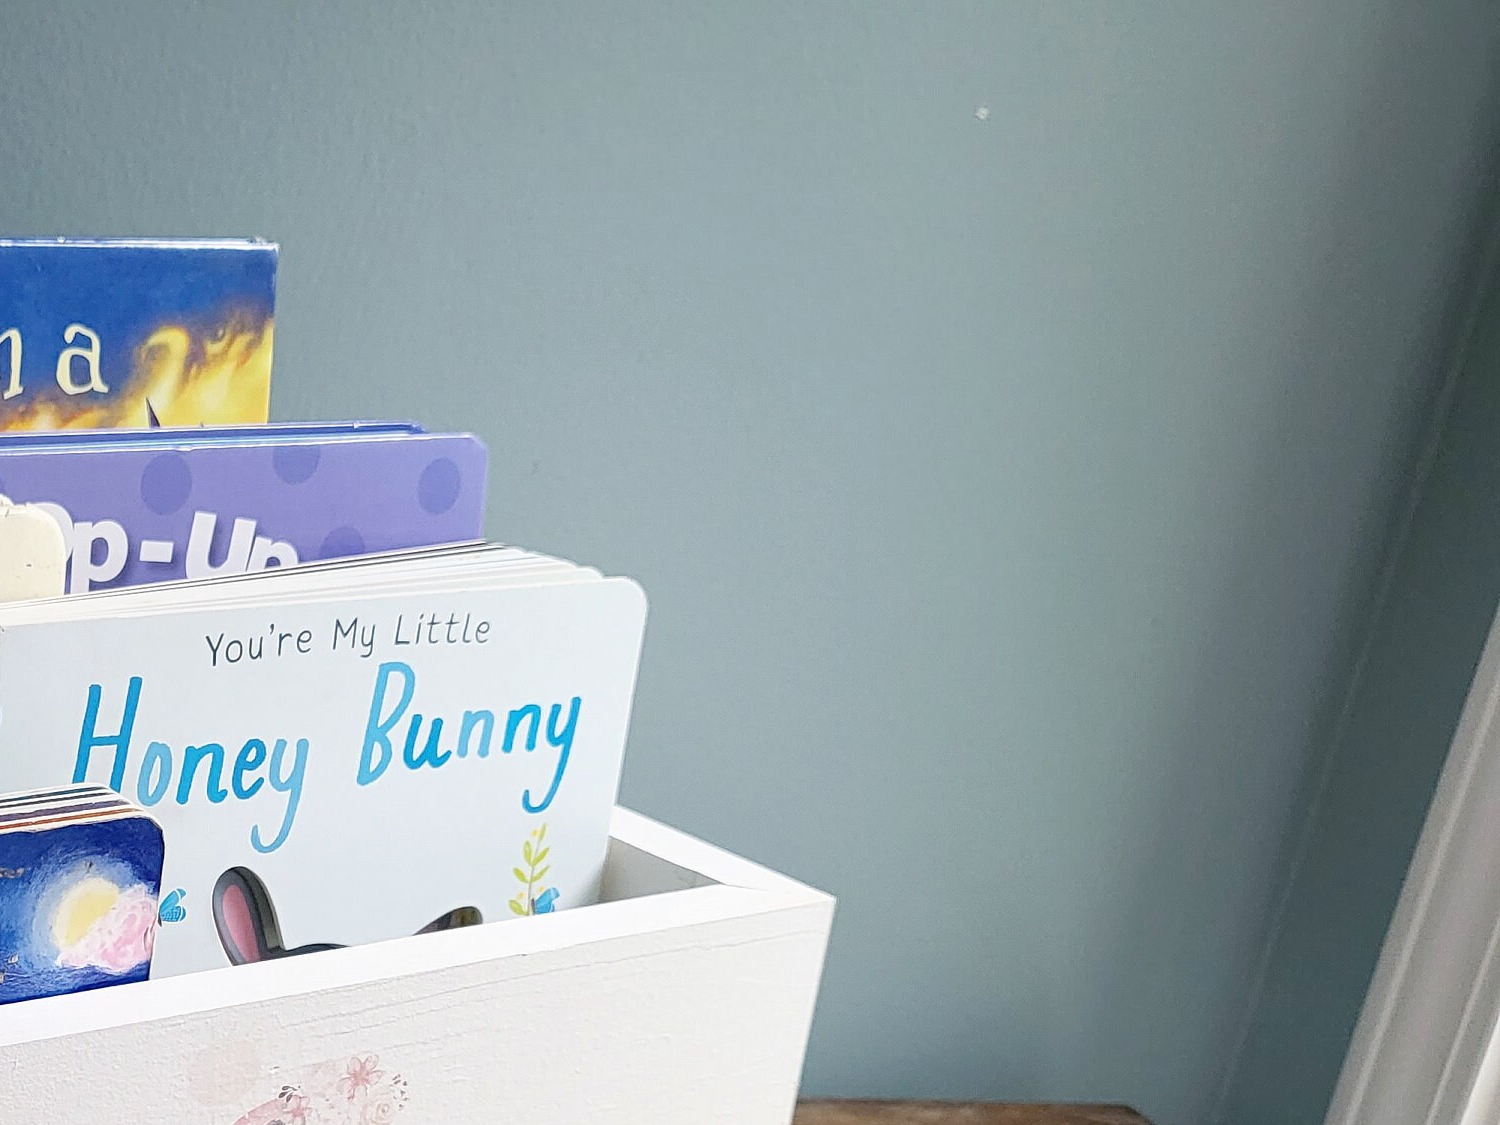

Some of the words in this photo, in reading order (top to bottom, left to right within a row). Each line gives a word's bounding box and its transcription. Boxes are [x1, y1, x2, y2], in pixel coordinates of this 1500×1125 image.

[56, 322, 109, 395] a
[26, 502, 298, 593] p-U
[205, 624, 313, 666] You're
[332, 617, 376, 658] My
[394, 613, 491, 646] Little
[71, 676, 309, 853] Honey
[356, 662, 582, 814] Bunny
